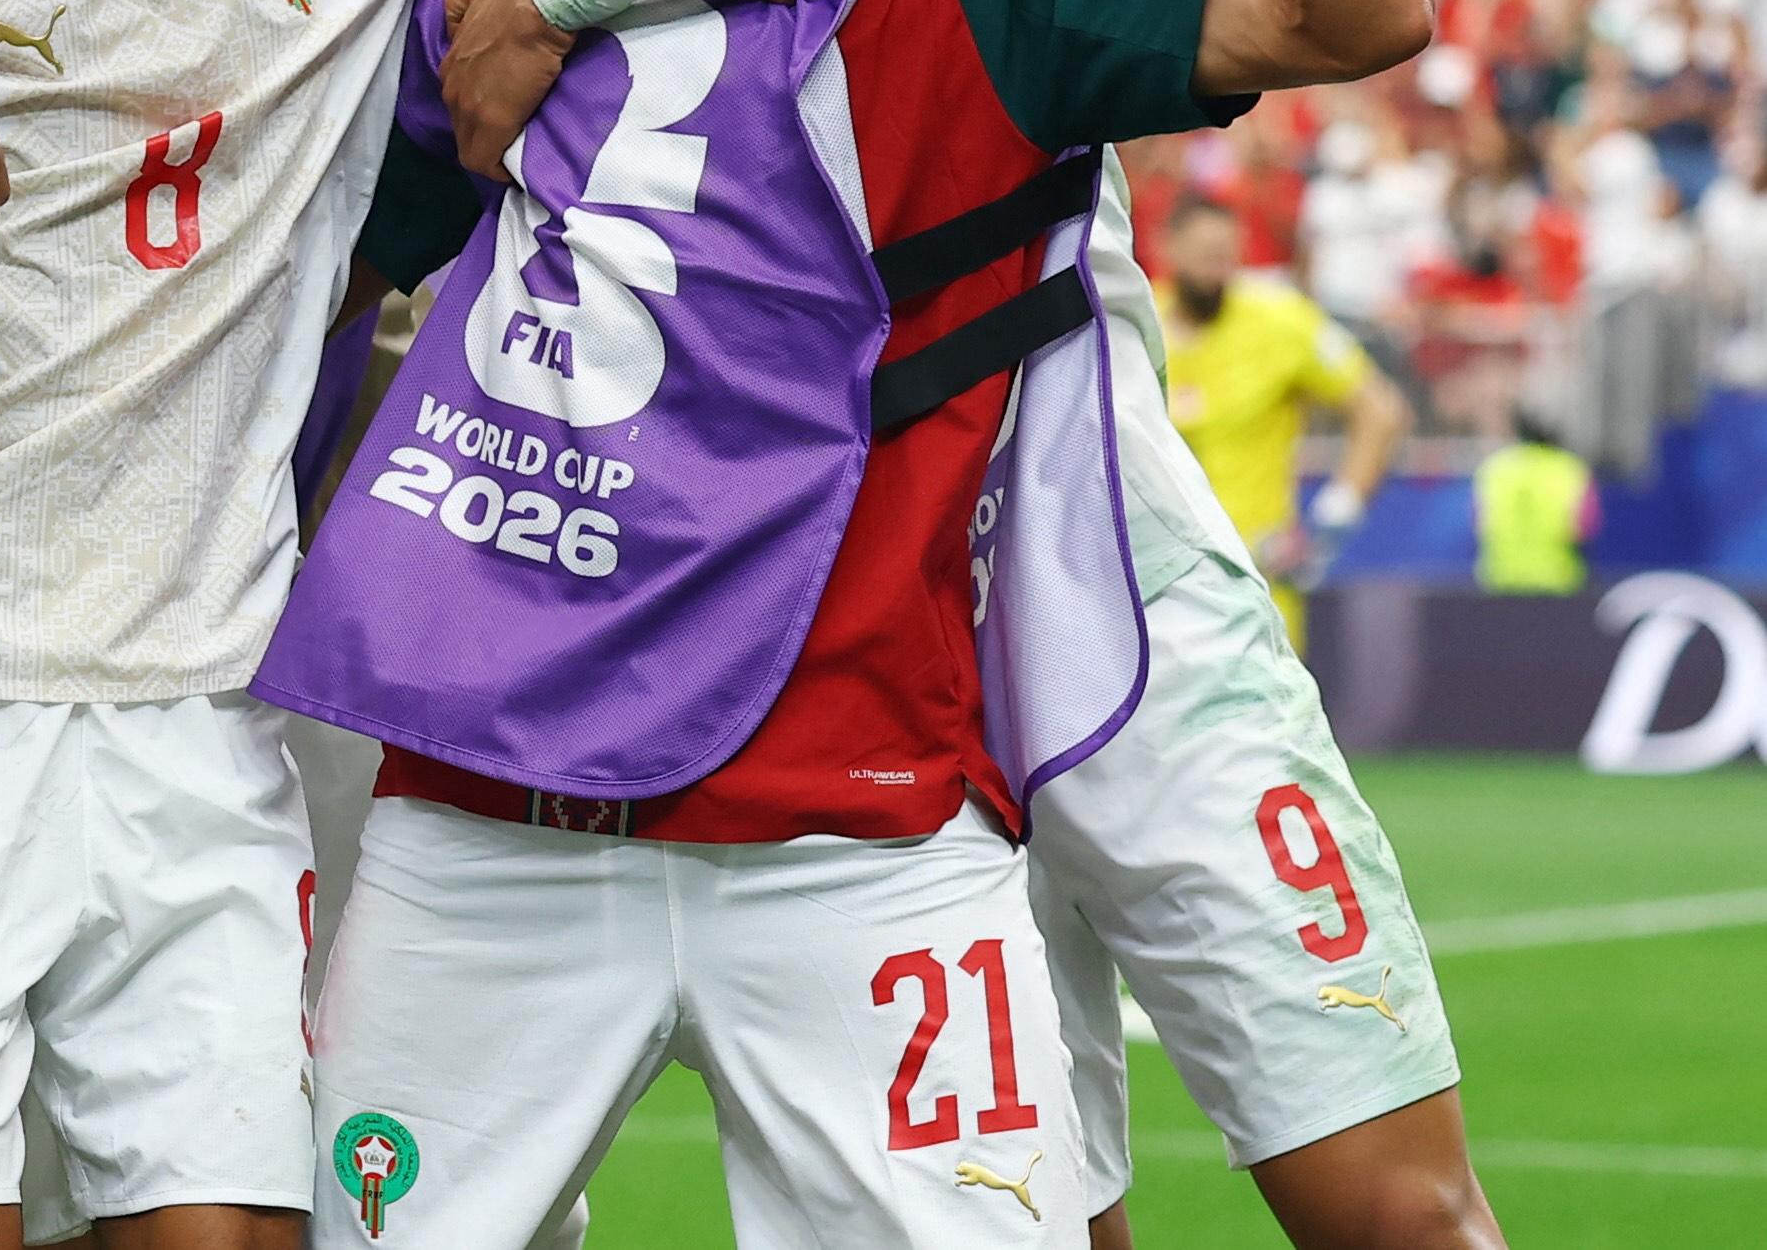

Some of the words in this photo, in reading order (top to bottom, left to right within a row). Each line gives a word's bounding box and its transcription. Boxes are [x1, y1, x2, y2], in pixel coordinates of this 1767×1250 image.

[124, 111, 224, 271] 8
[415, 393, 548, 476] WORLD
[553, 447, 635, 500] CUP
[369, 446, 620, 578] 2026
[849, 769, 916, 780] ULTRAWEAVE
[1254, 782, 1369, 964] 9
[870, 938, 1039, 1152] 21
